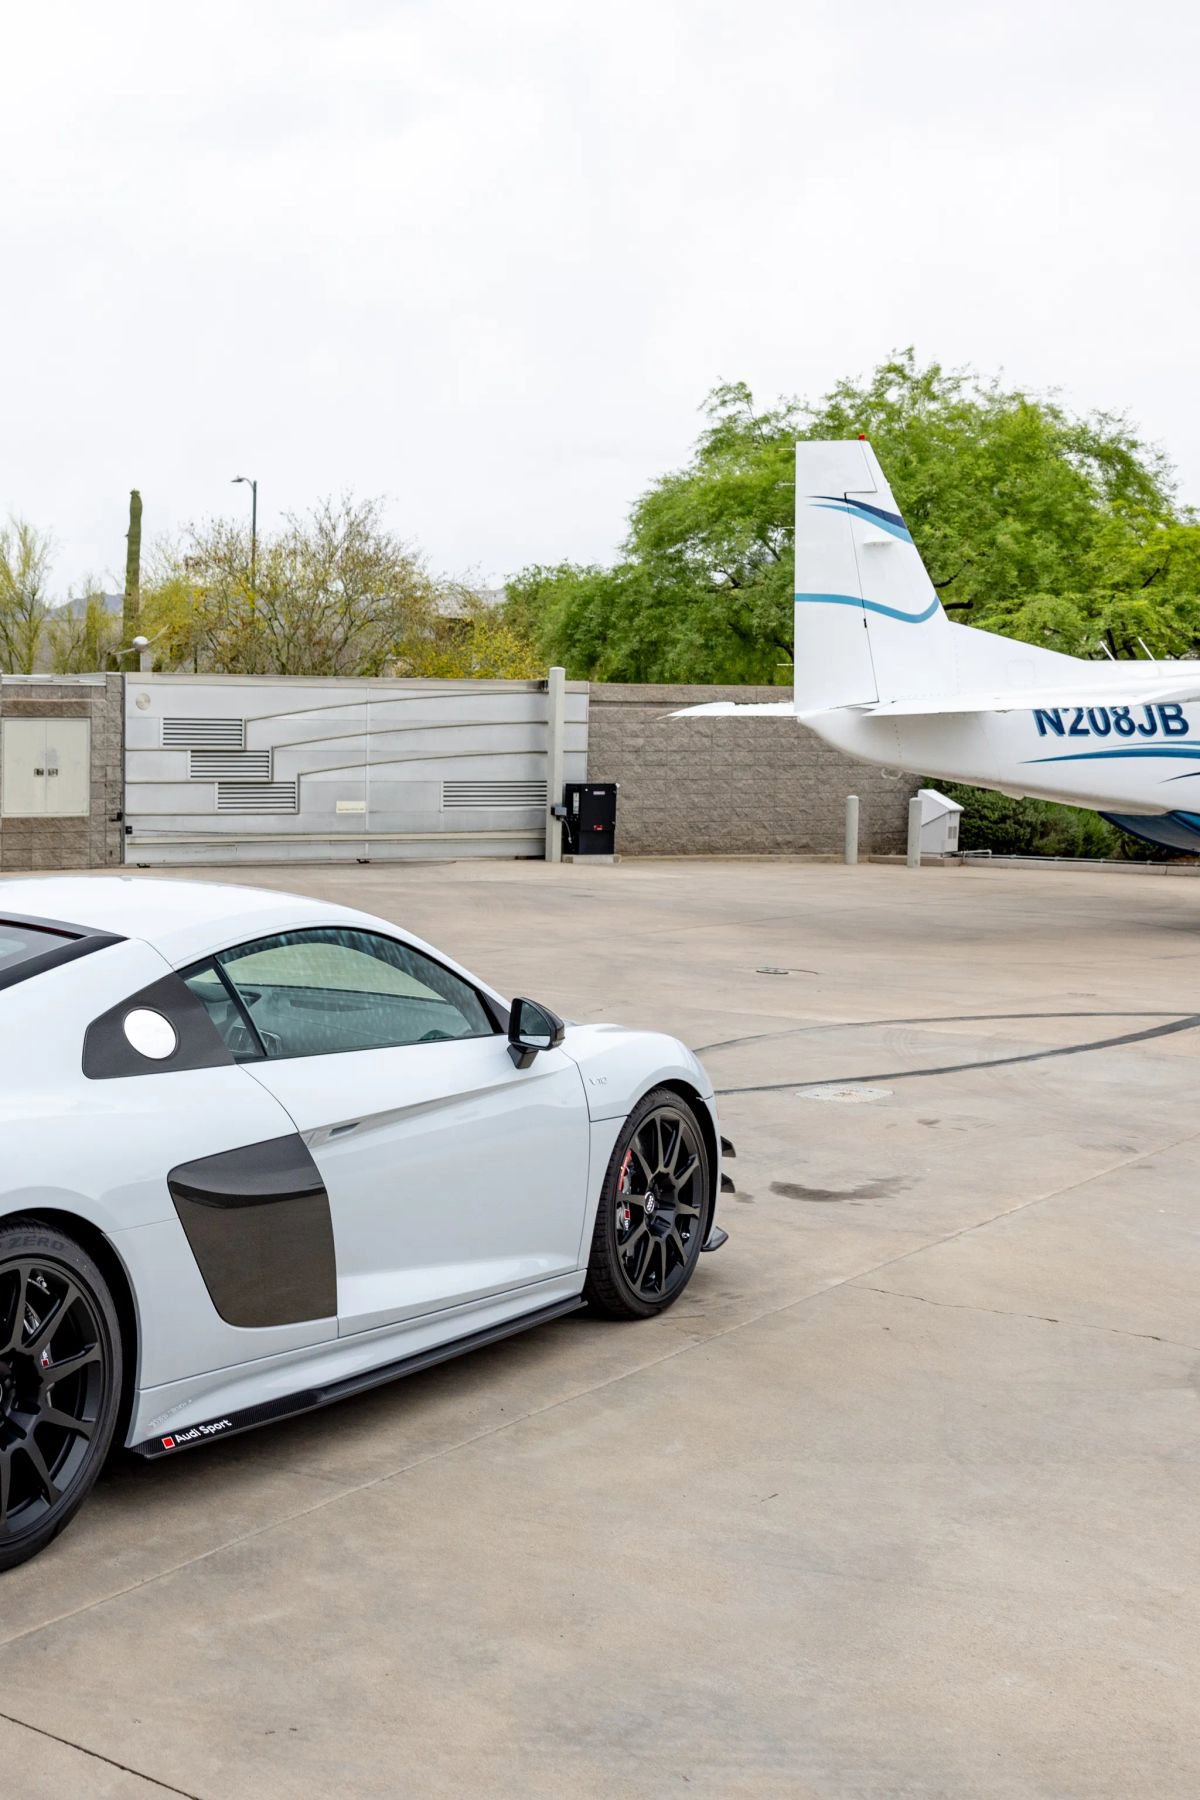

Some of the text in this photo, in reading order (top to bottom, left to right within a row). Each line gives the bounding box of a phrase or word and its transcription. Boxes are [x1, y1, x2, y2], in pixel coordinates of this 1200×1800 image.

[1032, 703, 1189, 737] N208JB
[8, 1235, 65, 1252] ZERO
[174, 1419, 232, 1443] Audi Sport
